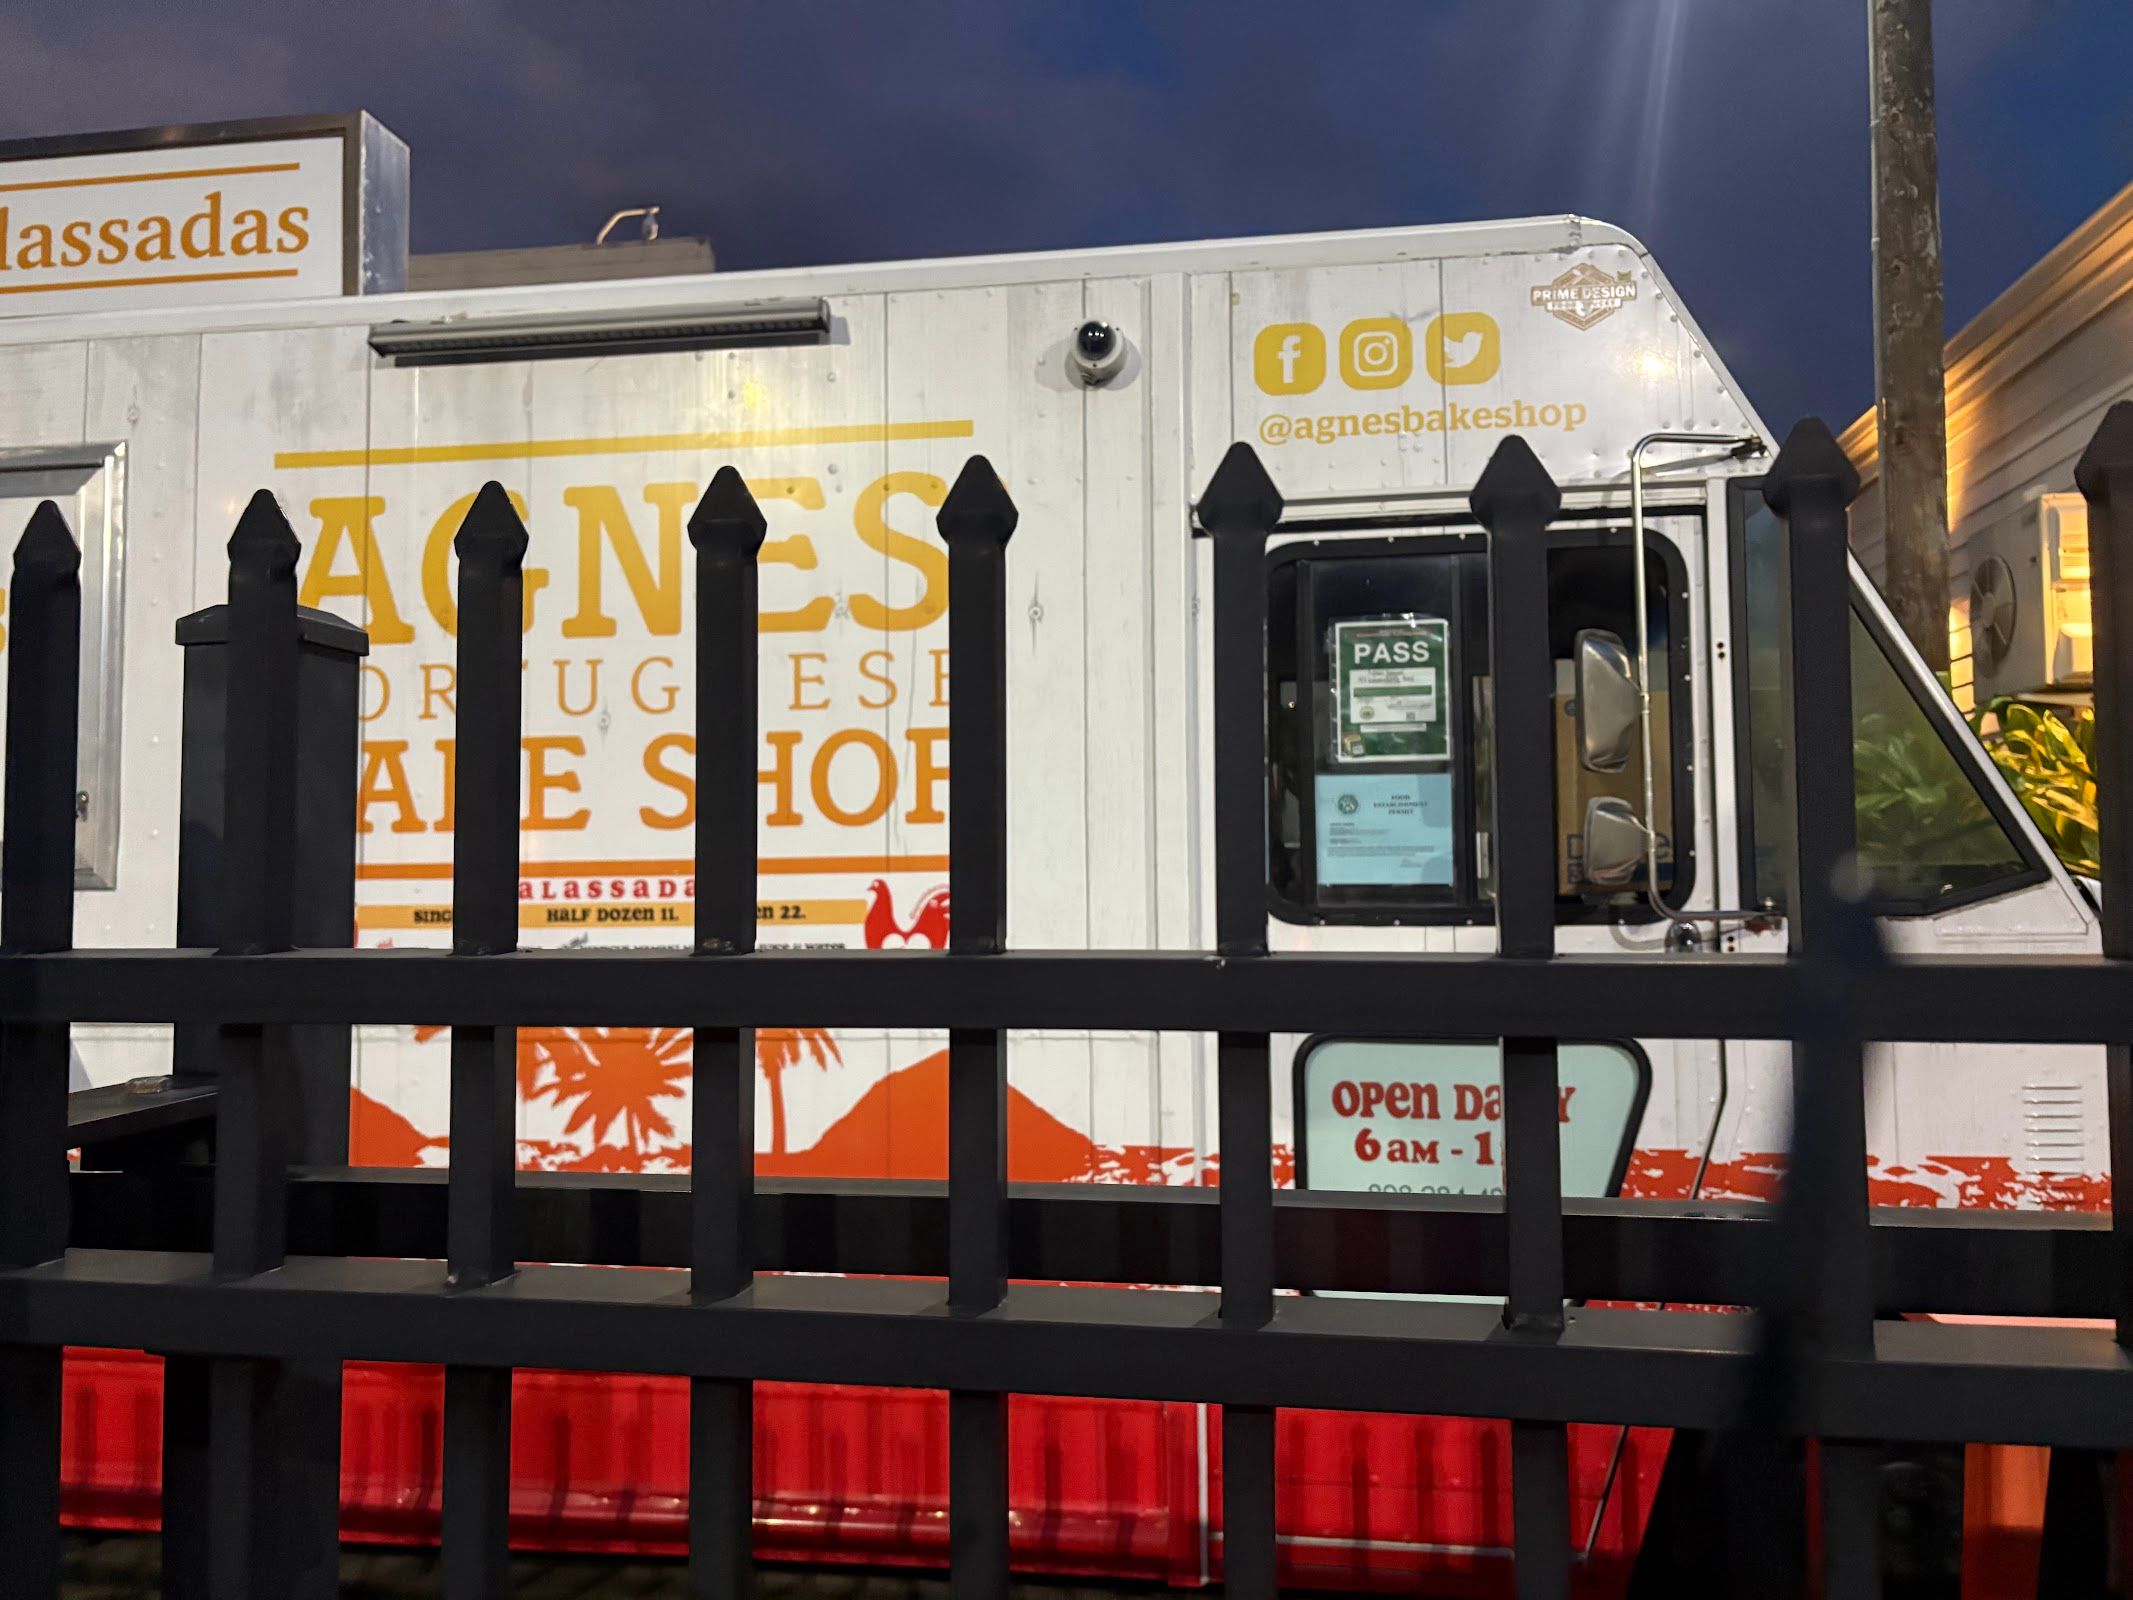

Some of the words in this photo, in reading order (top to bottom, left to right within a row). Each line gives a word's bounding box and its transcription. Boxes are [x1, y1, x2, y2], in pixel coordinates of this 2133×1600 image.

[1533, 287, 1578, 302] PRIME
[1583, 285, 1635, 299] DESIGN
[1260, 400, 1587, 445] @agnesbakeshop
[1354, 641, 1429, 664] PASS
